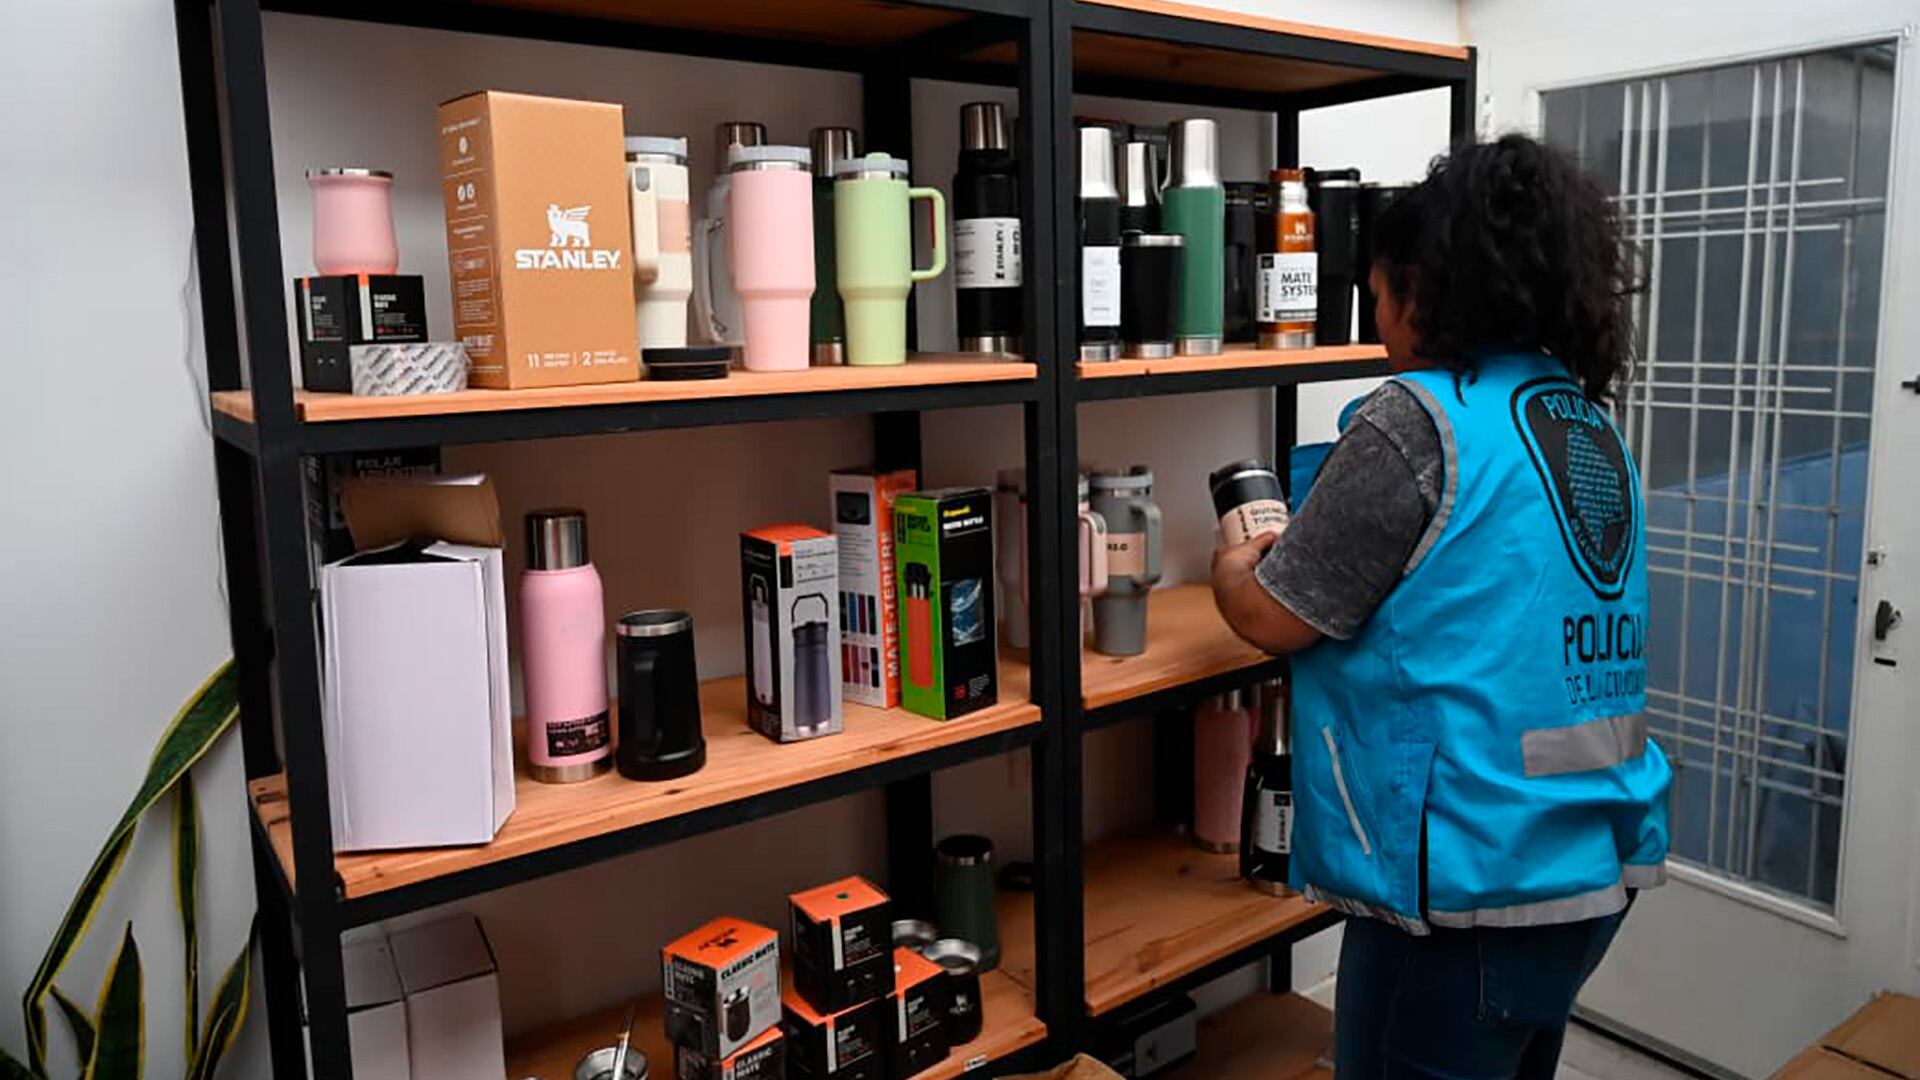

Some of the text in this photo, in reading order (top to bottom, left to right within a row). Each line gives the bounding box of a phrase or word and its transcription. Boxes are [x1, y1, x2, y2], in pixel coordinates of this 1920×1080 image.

[515, 249, 621, 270] STANLEY
[1280, 272, 1312, 284] MATE
[582, 351, 592, 367] 2
